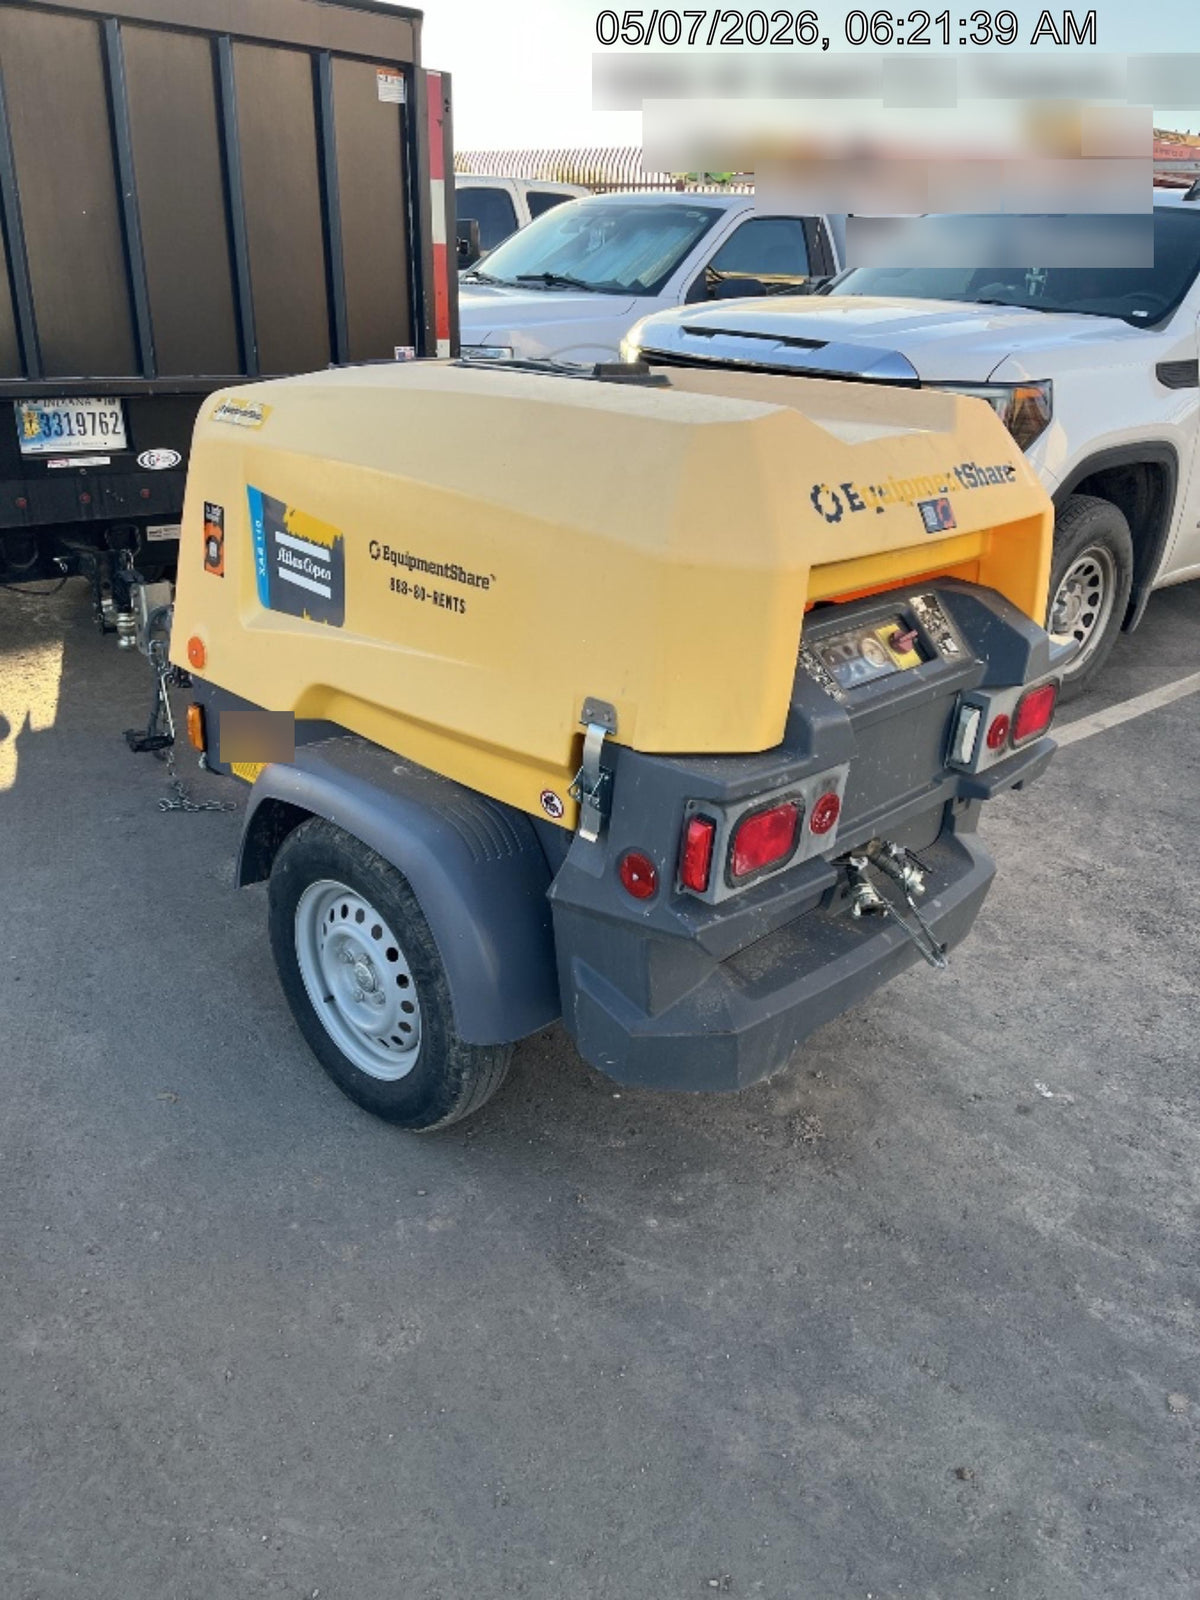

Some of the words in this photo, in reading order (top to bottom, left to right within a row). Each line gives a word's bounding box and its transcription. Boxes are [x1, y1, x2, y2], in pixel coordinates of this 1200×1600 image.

[40, 411, 121, 438] 3319762
[382, 544, 491, 590] EquipmentShare
[389, 577, 467, 614] 888-80-RENTS
